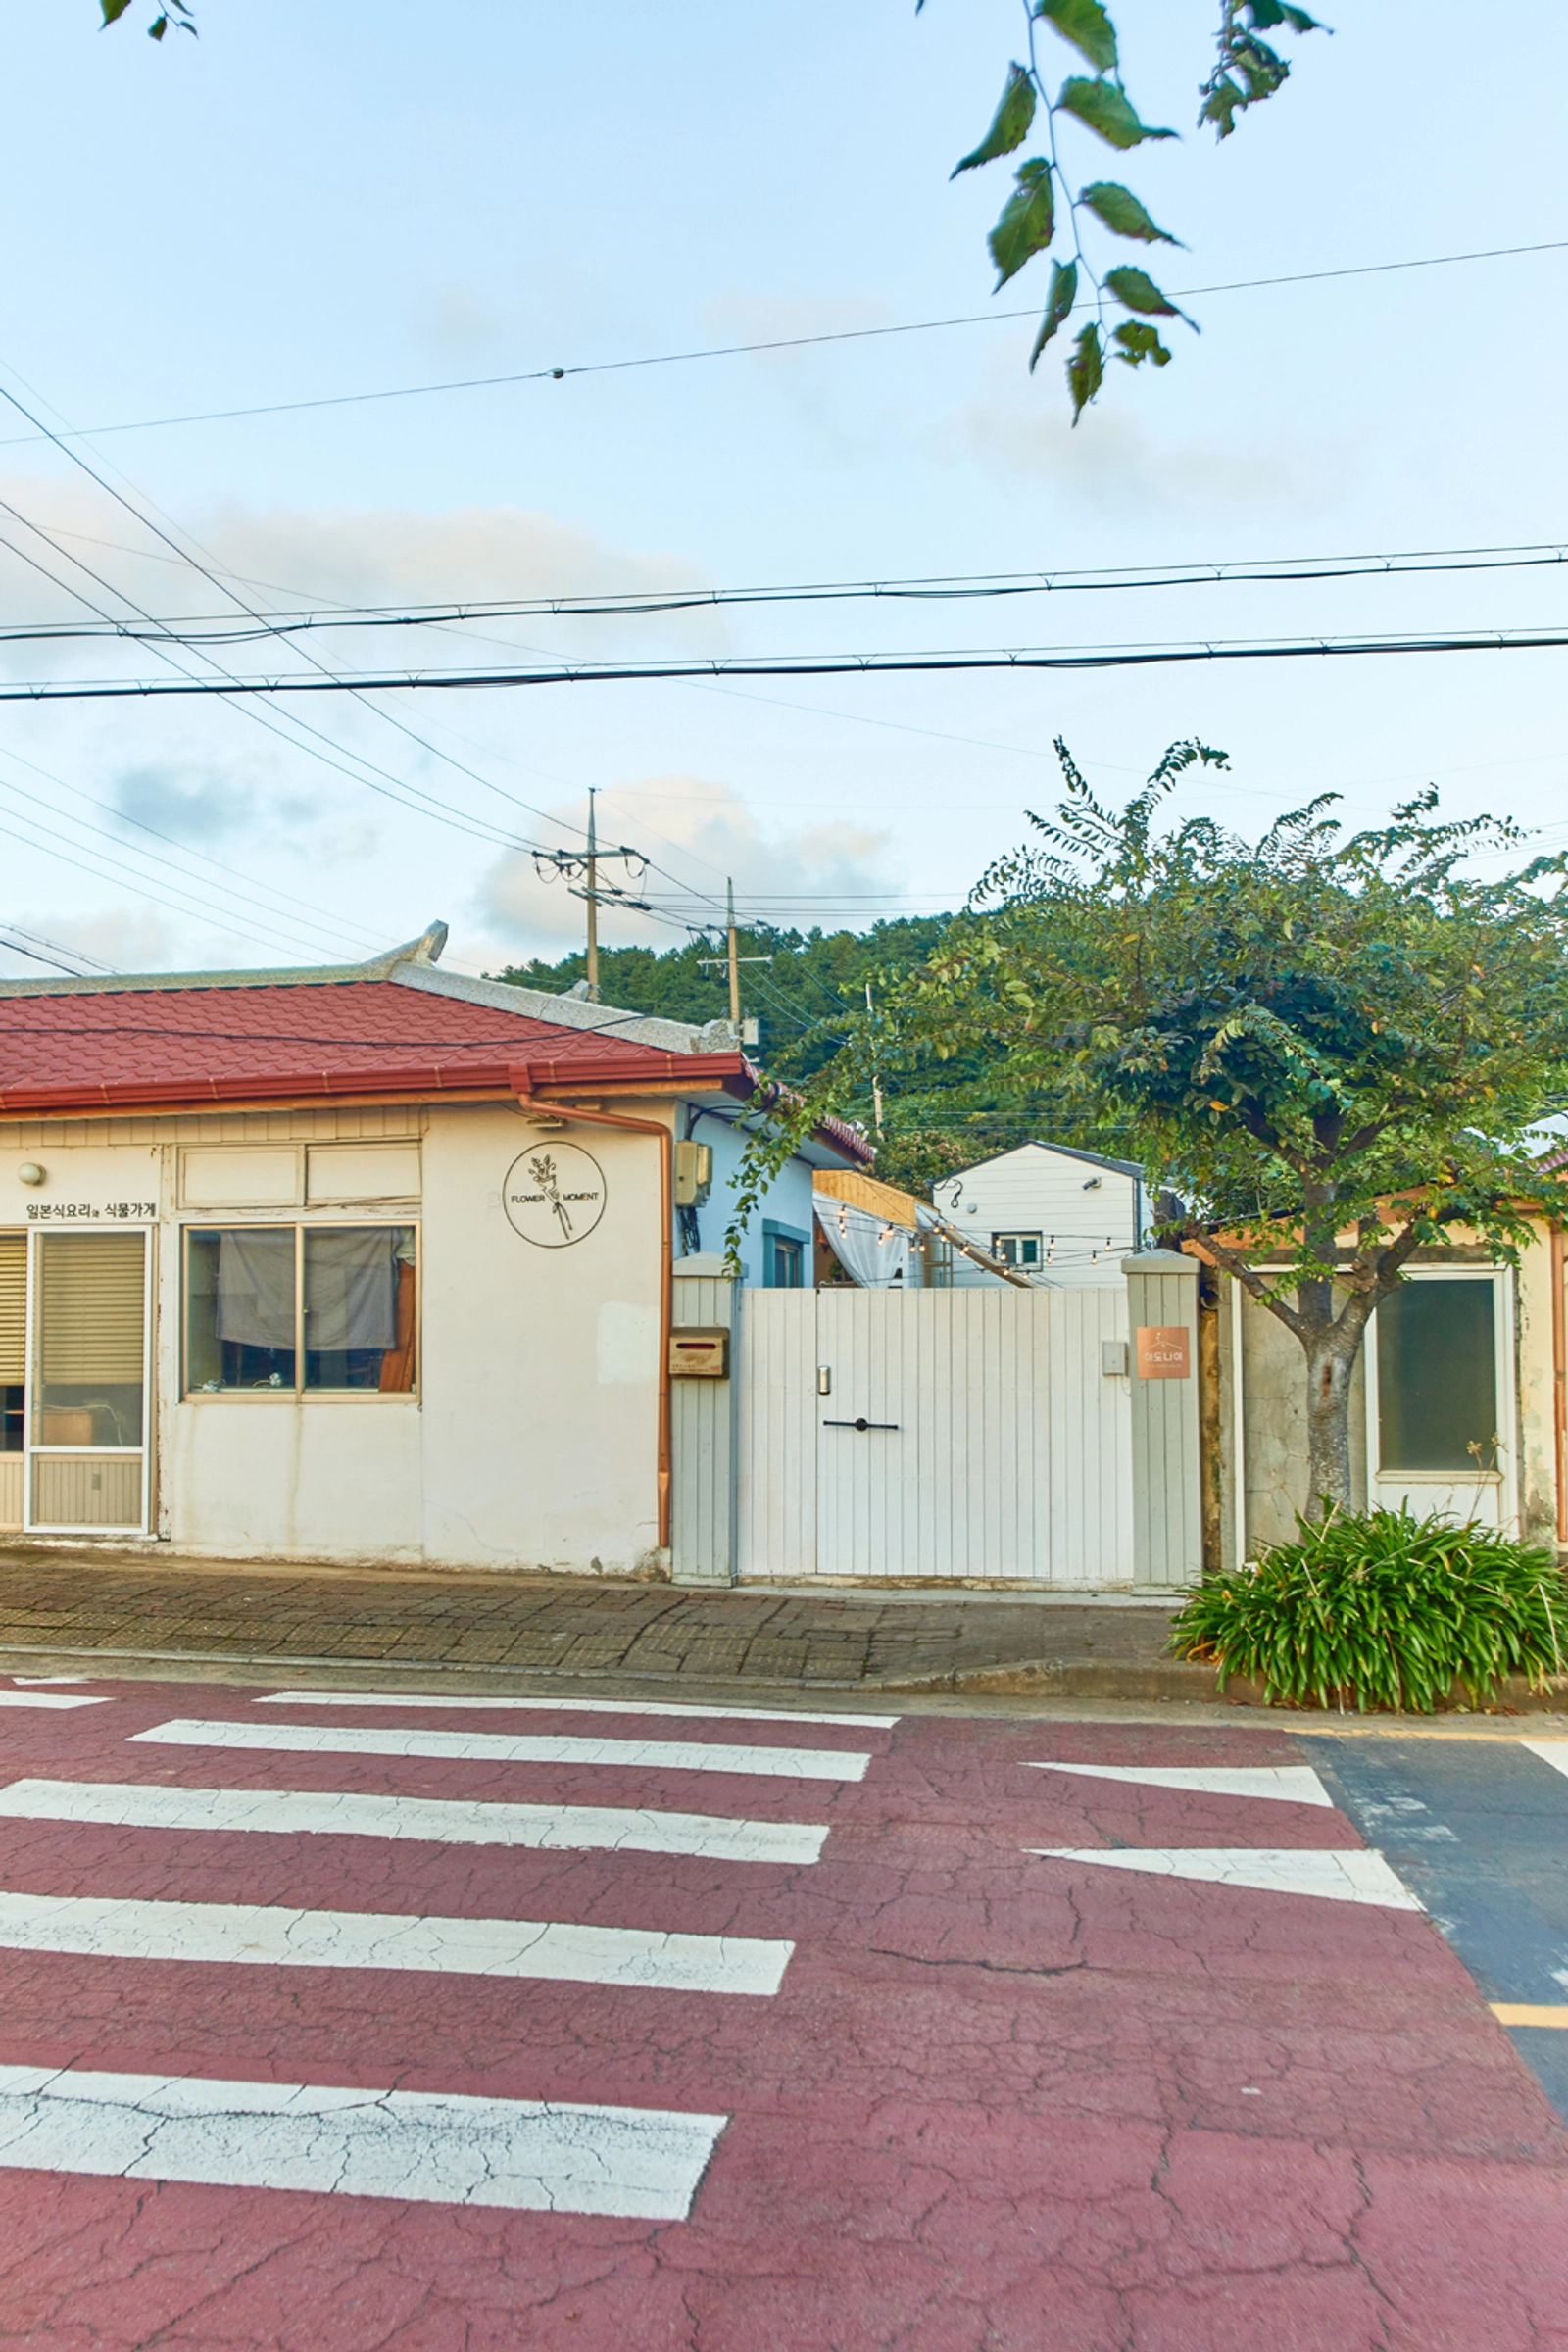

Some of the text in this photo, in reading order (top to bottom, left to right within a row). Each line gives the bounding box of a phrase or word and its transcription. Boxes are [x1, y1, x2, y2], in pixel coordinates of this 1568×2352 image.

[511, 1192, 599, 1203] FLOWER MOMENT
[104, 1202, 156, 1218] 식물가게
